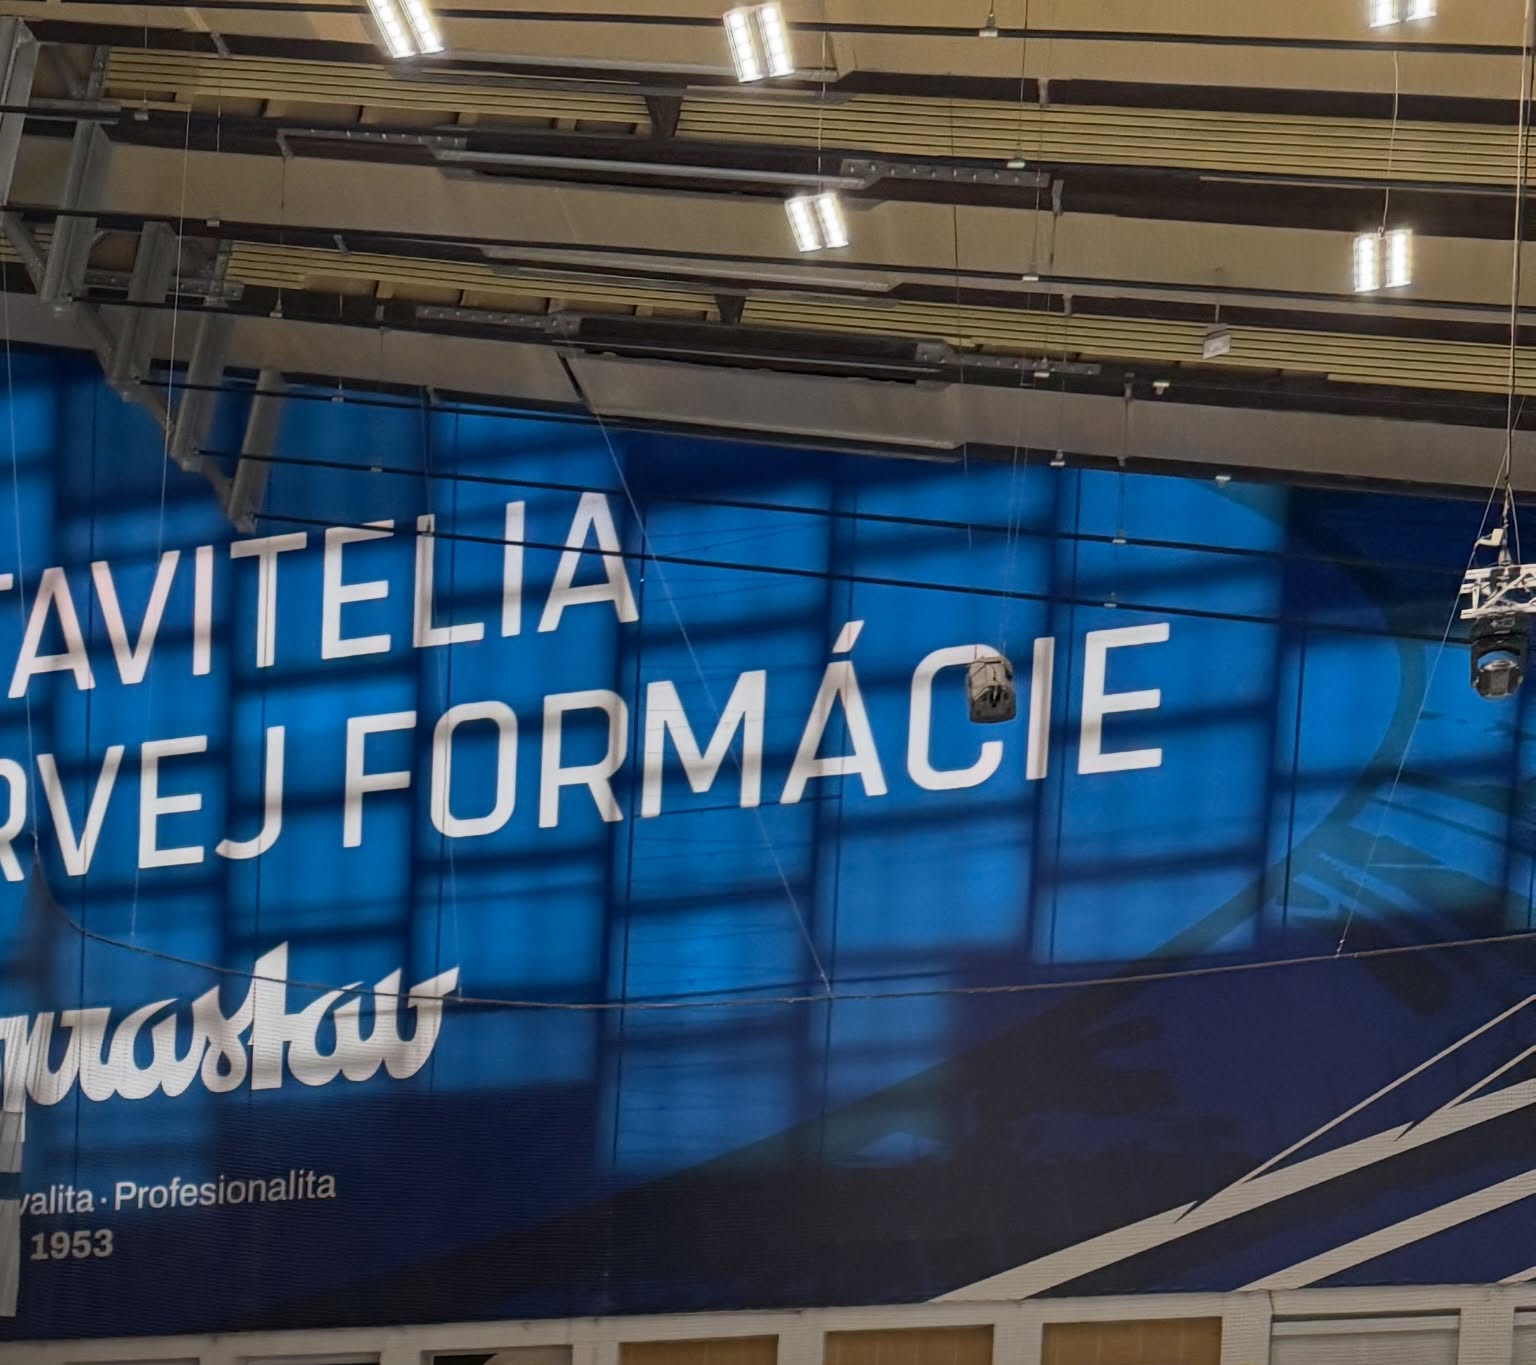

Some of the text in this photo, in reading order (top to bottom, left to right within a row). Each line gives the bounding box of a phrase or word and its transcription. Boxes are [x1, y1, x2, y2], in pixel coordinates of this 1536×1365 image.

[342, 620, 1172, 851] FORMÁCIE
[21, 1184, 94, 1217] valita
[114, 1169, 336, 1210] Profesionalita
[30, 1228, 113, 1261] 1953
